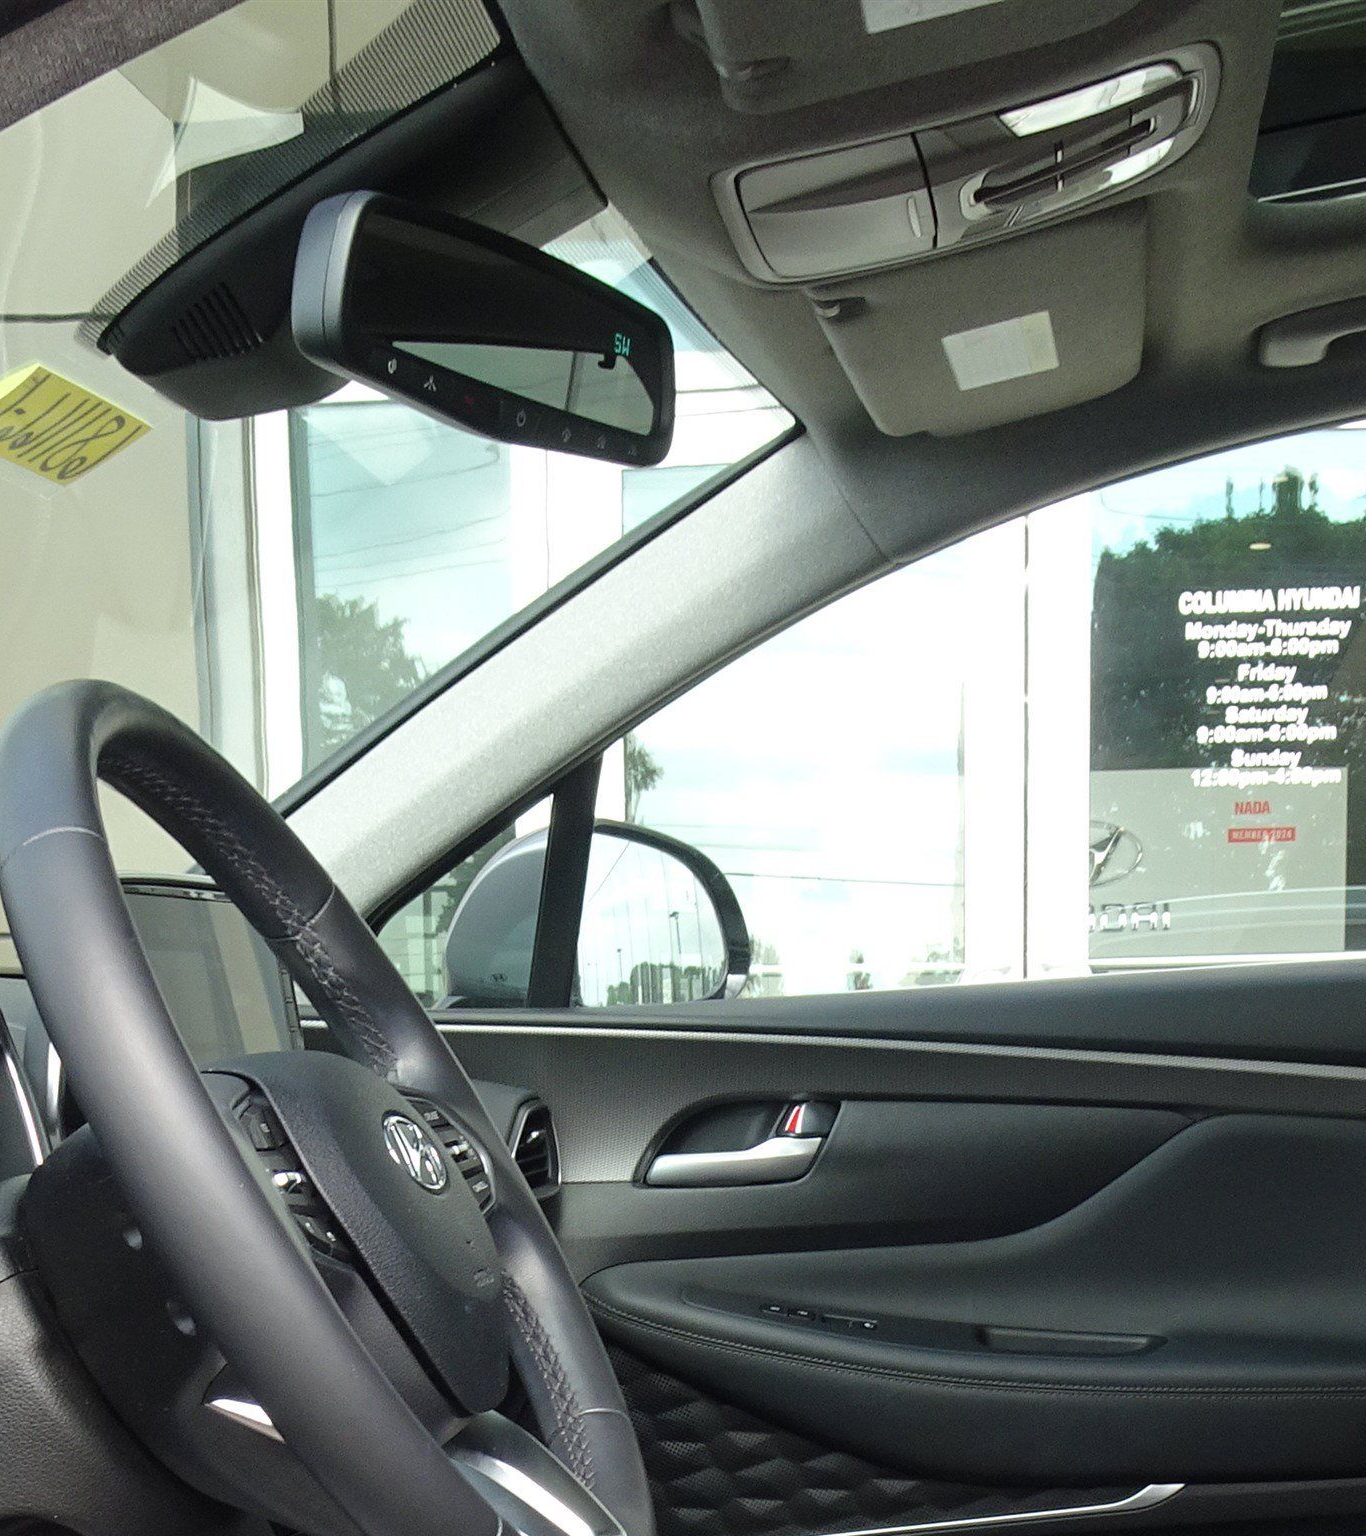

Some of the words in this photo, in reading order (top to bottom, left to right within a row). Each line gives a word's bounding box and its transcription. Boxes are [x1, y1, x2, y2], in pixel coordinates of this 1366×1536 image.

[1277, 585, 1361, 611] HYUNDAI
[1237, 663, 1298, 684] Friday
[1225, 704, 1309, 725] Saturday
[1231, 748, 1302, 770] Sunday
[1234, 801, 1271, 815] NADA
